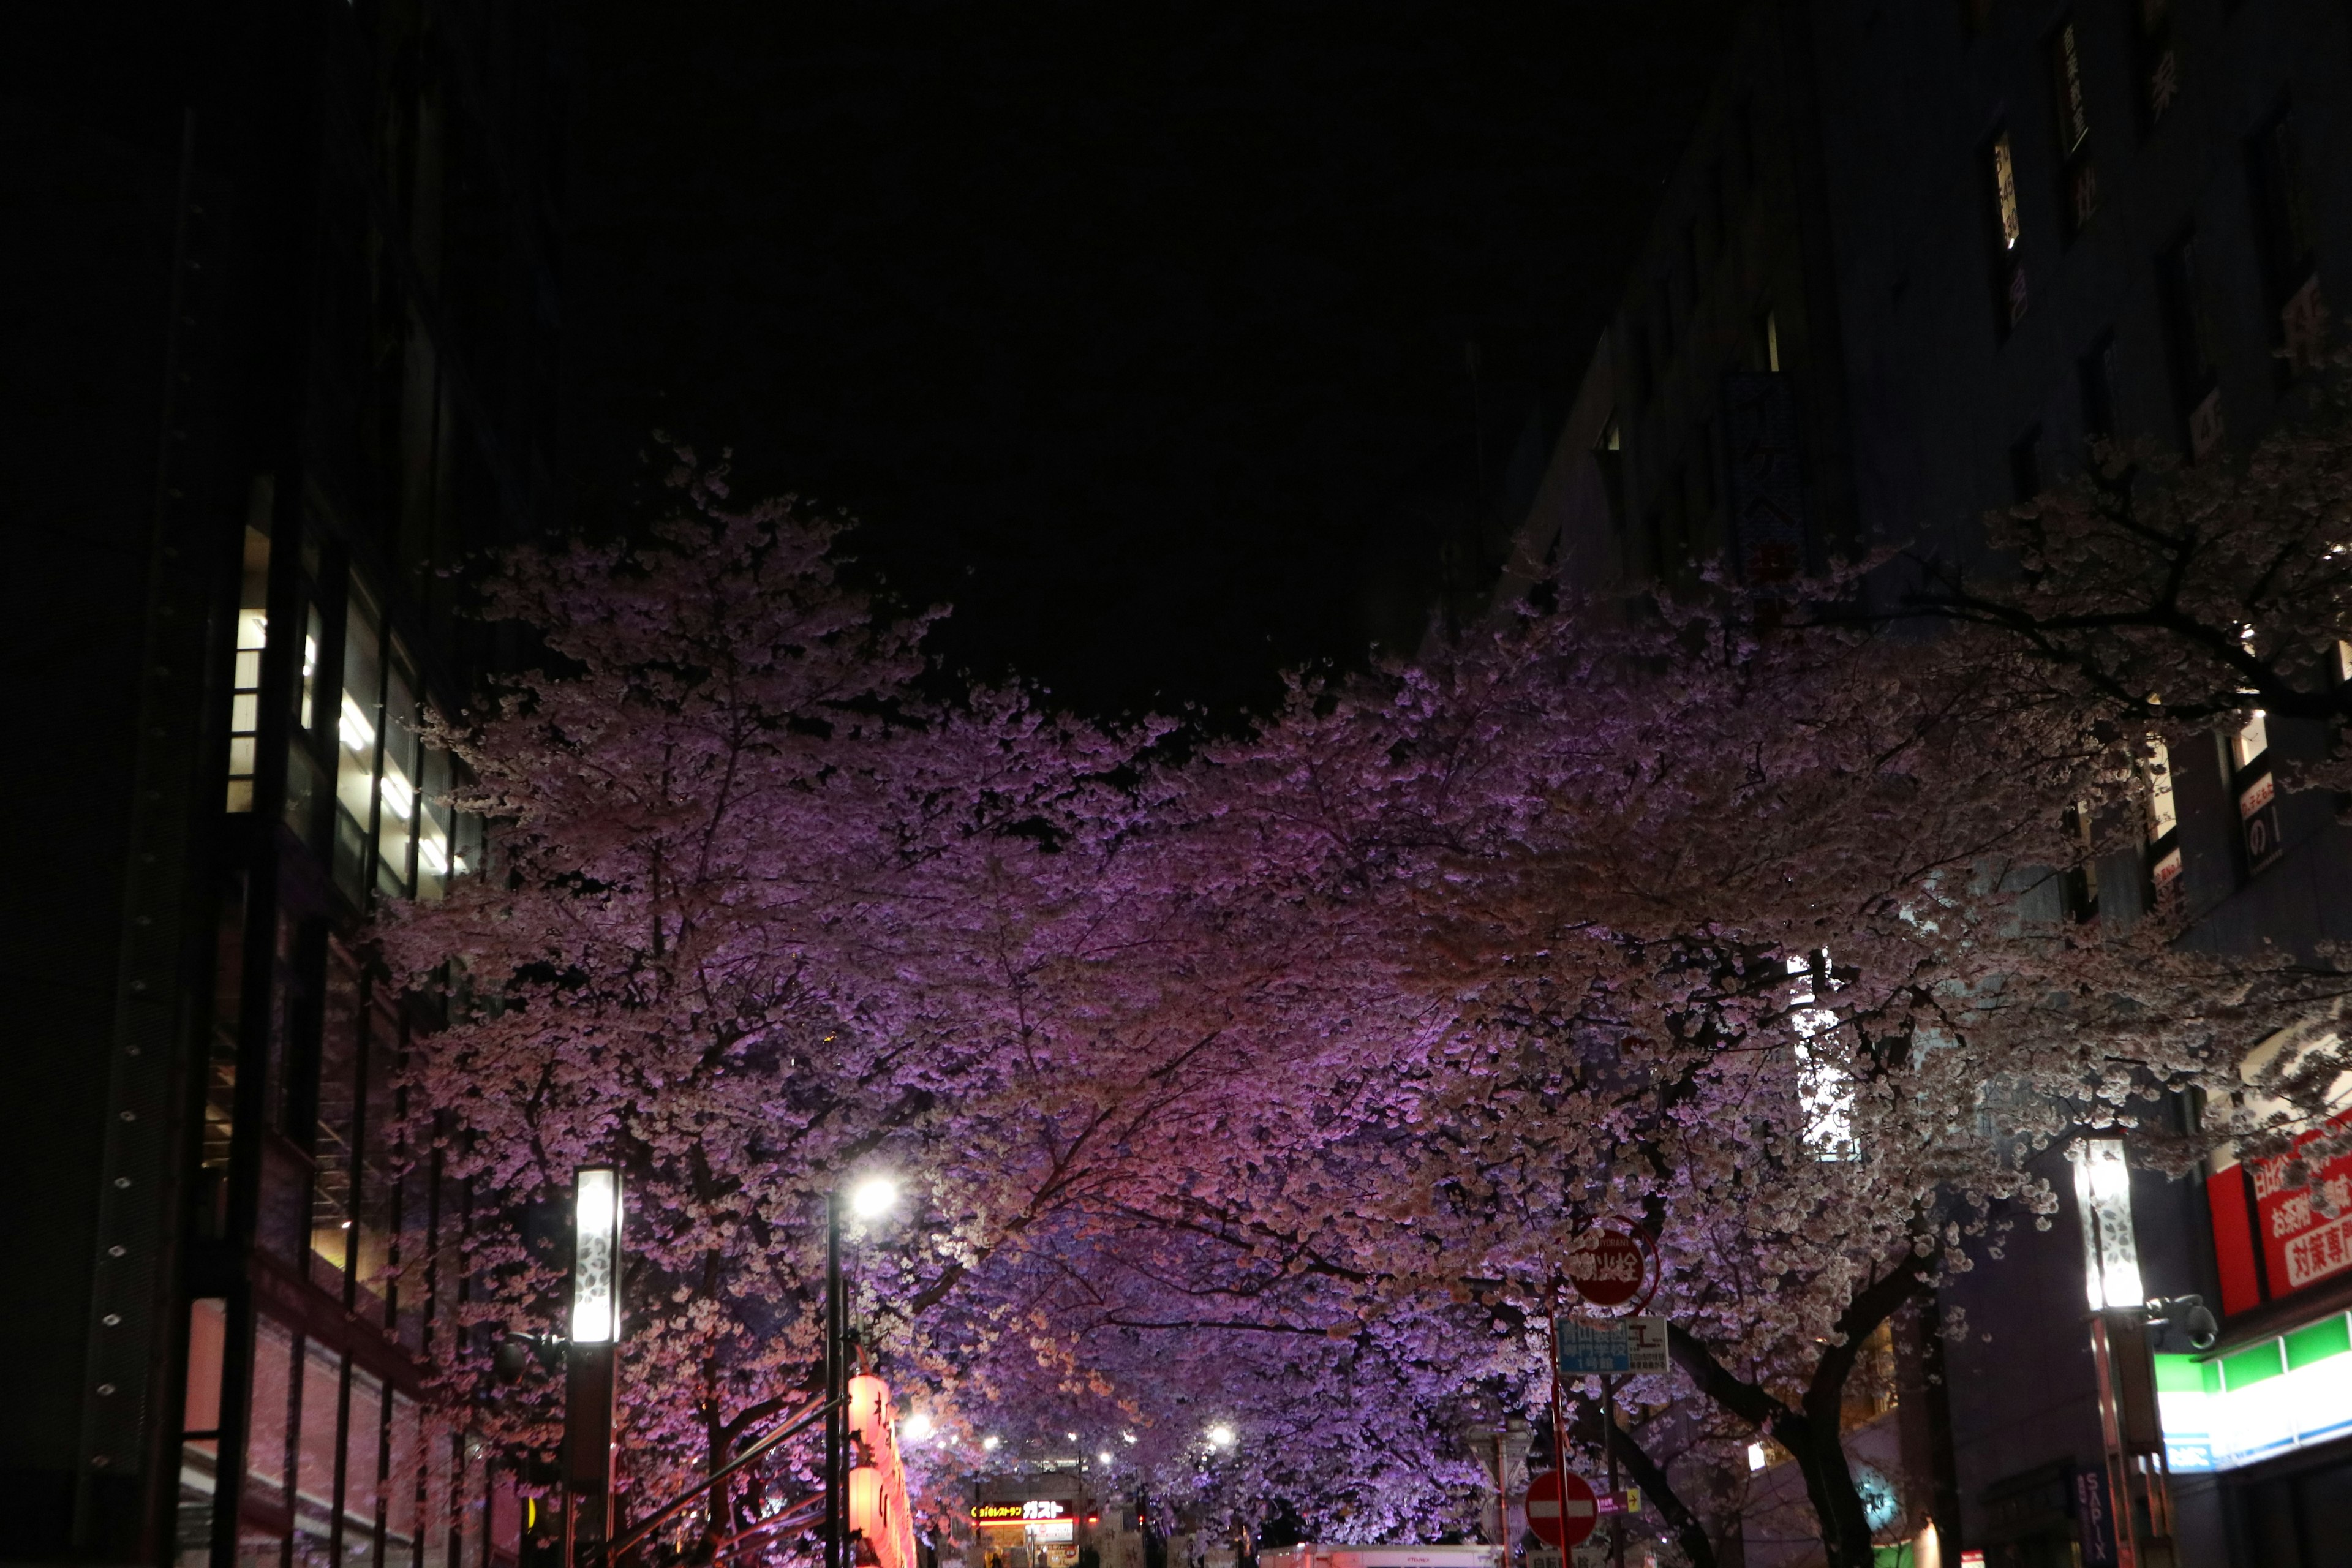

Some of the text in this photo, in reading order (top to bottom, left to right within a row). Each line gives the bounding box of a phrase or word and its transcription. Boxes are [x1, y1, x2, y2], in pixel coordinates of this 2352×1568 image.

[1573, 1251, 1639, 1282] 火栓
[1023, 1501, 1063, 1519] ガスト
[2086, 1472, 2106, 1560] SAPIX
